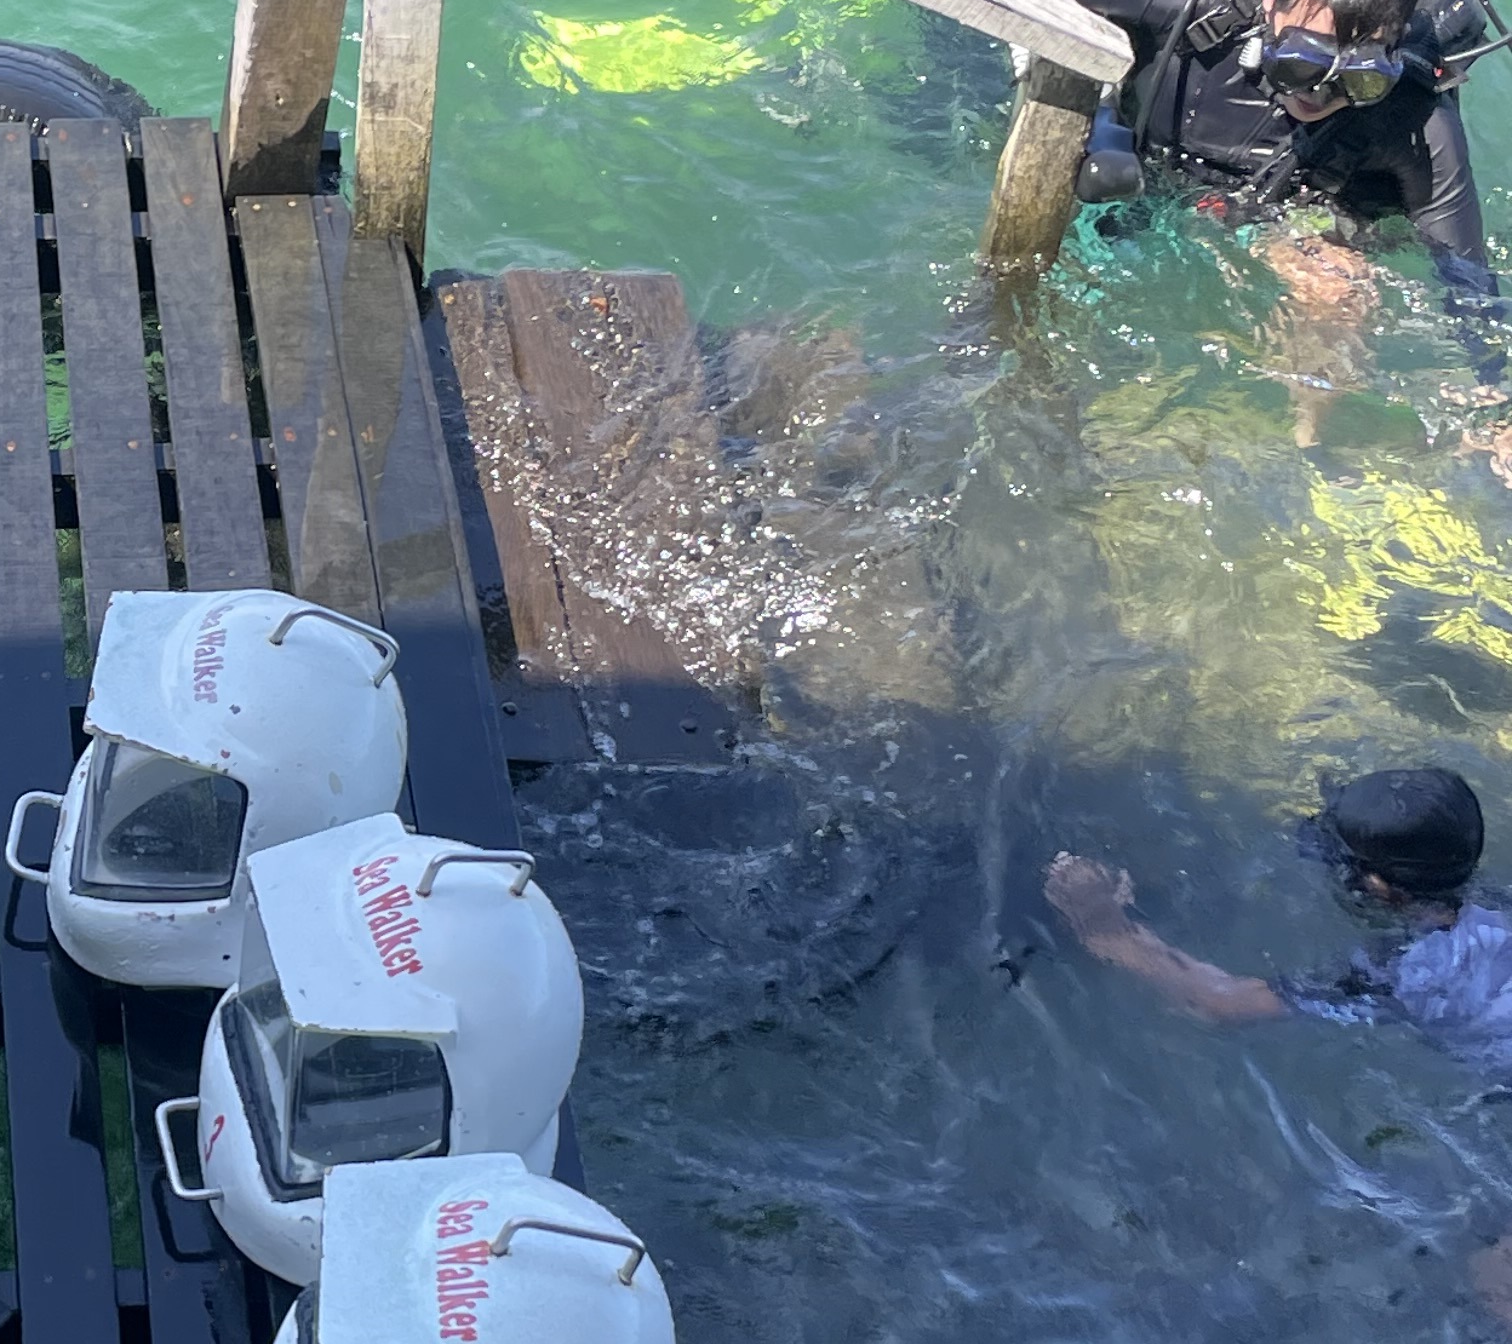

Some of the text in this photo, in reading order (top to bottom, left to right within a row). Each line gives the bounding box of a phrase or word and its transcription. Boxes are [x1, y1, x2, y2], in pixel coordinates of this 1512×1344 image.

[193, 605, 234, 704] Sea Walker
[352, 856, 423, 977] Sea Walker
[436, 1200, 489, 1342] Sea Walker
